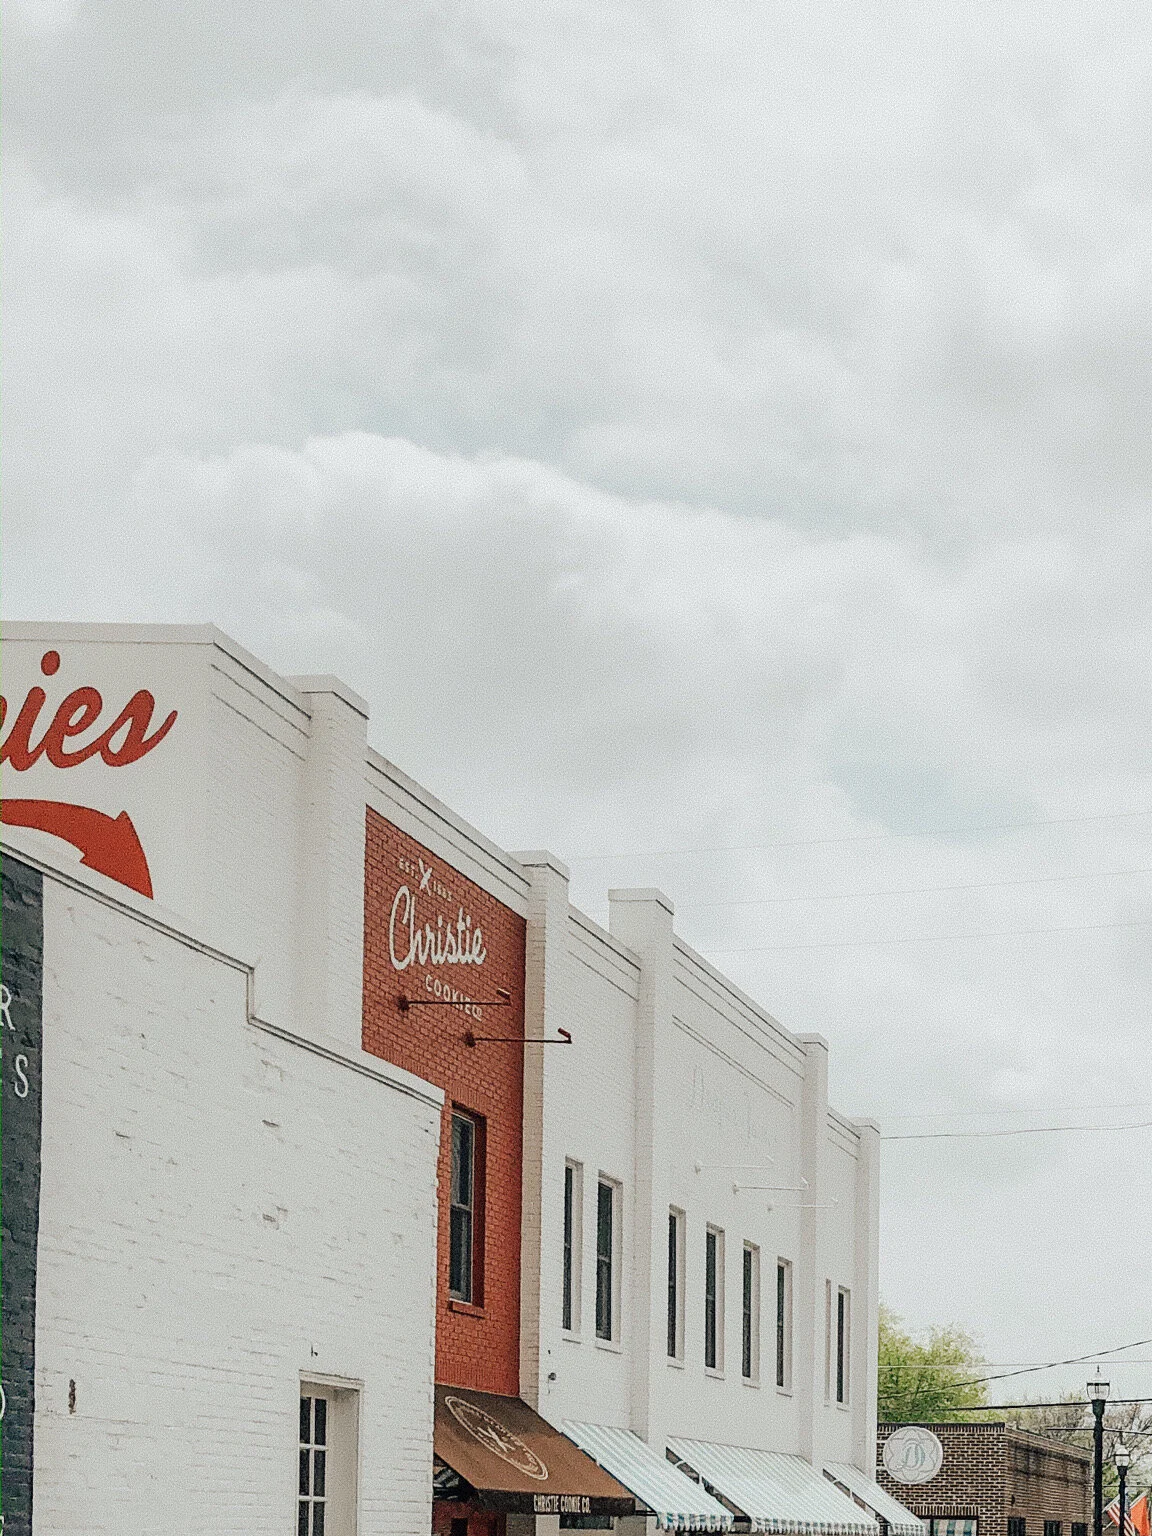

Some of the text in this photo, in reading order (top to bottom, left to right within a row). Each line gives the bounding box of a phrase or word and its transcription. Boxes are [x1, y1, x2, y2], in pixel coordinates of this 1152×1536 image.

[0, 650, 178, 771] ies
[389, 885, 487, 970] Christie
[425, 974, 471, 1015] COOKIE
[533, 1494, 559, 1513] CHRISTIE
[560, 1495, 581, 1513] COOKIE
